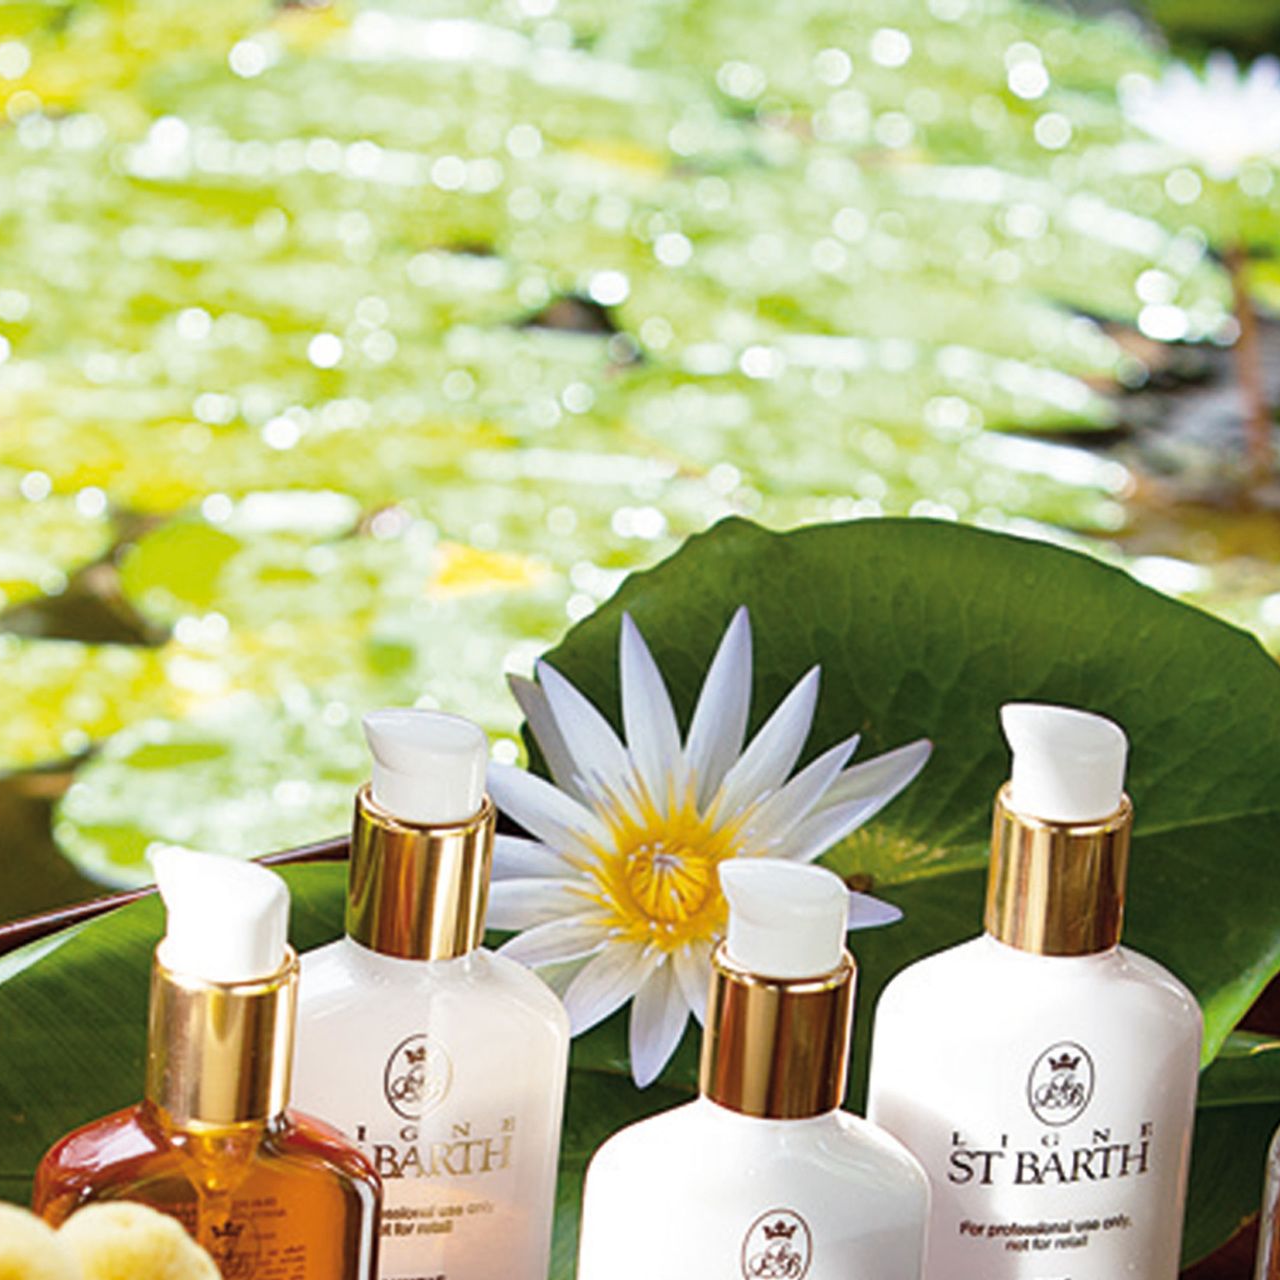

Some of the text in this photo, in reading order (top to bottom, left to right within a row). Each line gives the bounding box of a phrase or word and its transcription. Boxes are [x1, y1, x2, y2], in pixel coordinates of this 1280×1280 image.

[356, 1116, 516, 1142] IGNE
[952, 1122, 1153, 1148] LIGNE
[373, 1136, 513, 1179] BARTH
[948, 1141, 1149, 1185] ST BARTH
[394, 1223, 414, 1236] for
[959, 1221, 984, 1236] For
[987, 1220, 1071, 1238] professional
[1075, 1220, 1100, 1232] use
[1006, 1235, 1088, 1252] not for retail
